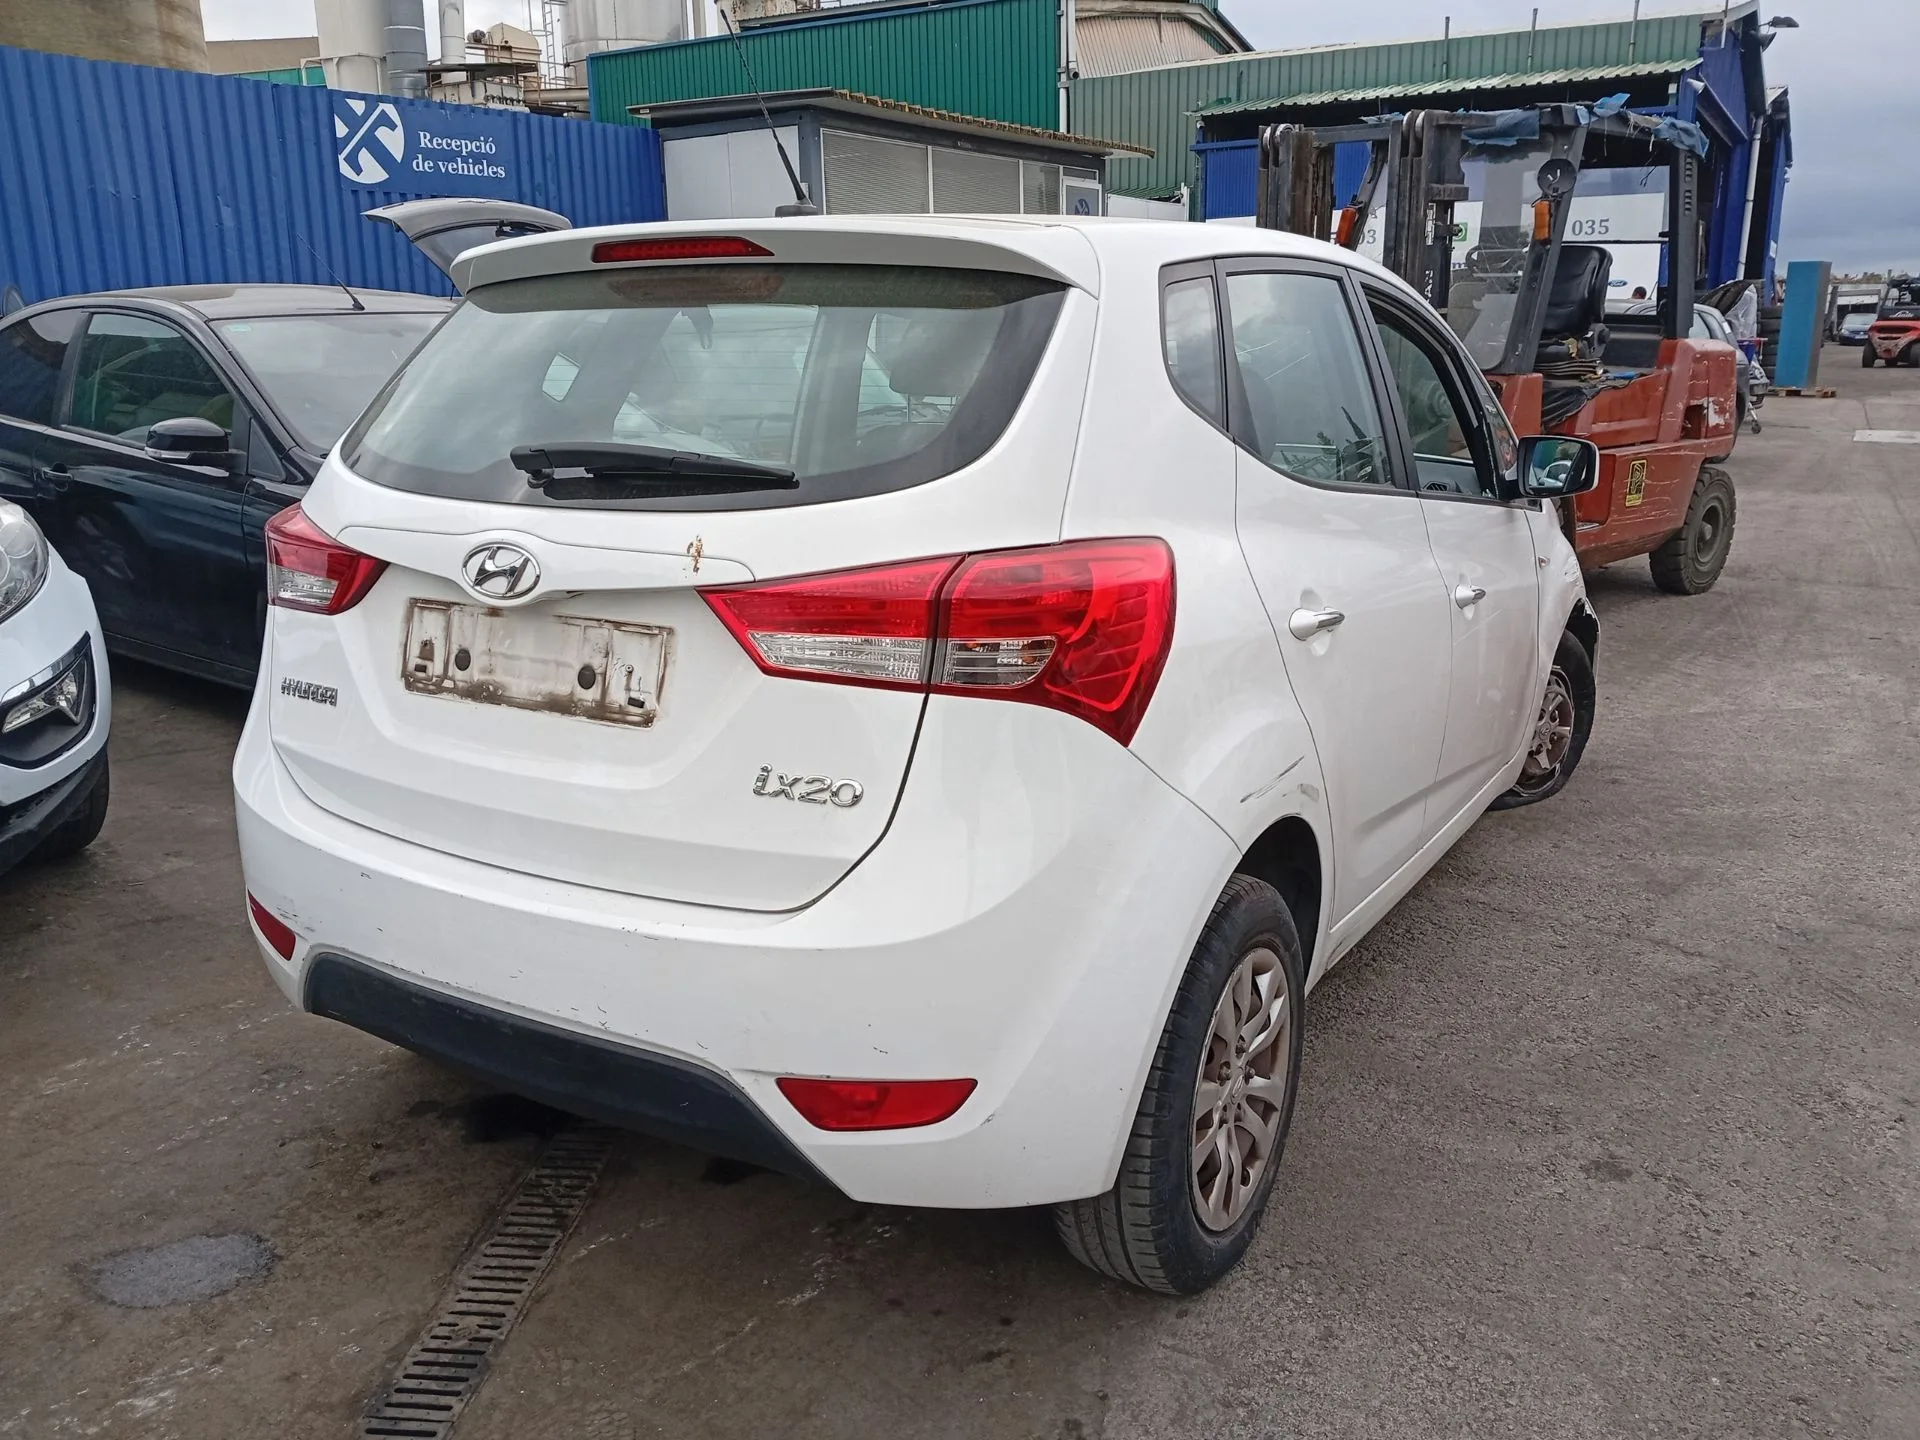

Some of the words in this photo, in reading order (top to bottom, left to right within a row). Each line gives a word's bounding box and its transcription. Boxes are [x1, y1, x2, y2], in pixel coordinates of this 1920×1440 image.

[418, 131, 496, 155] Recepció
[412, 154, 435, 173] de
[438, 157, 506, 178] vehicles
[1571, 217, 1610, 236] 035
[752, 763, 864, 808] ix20
